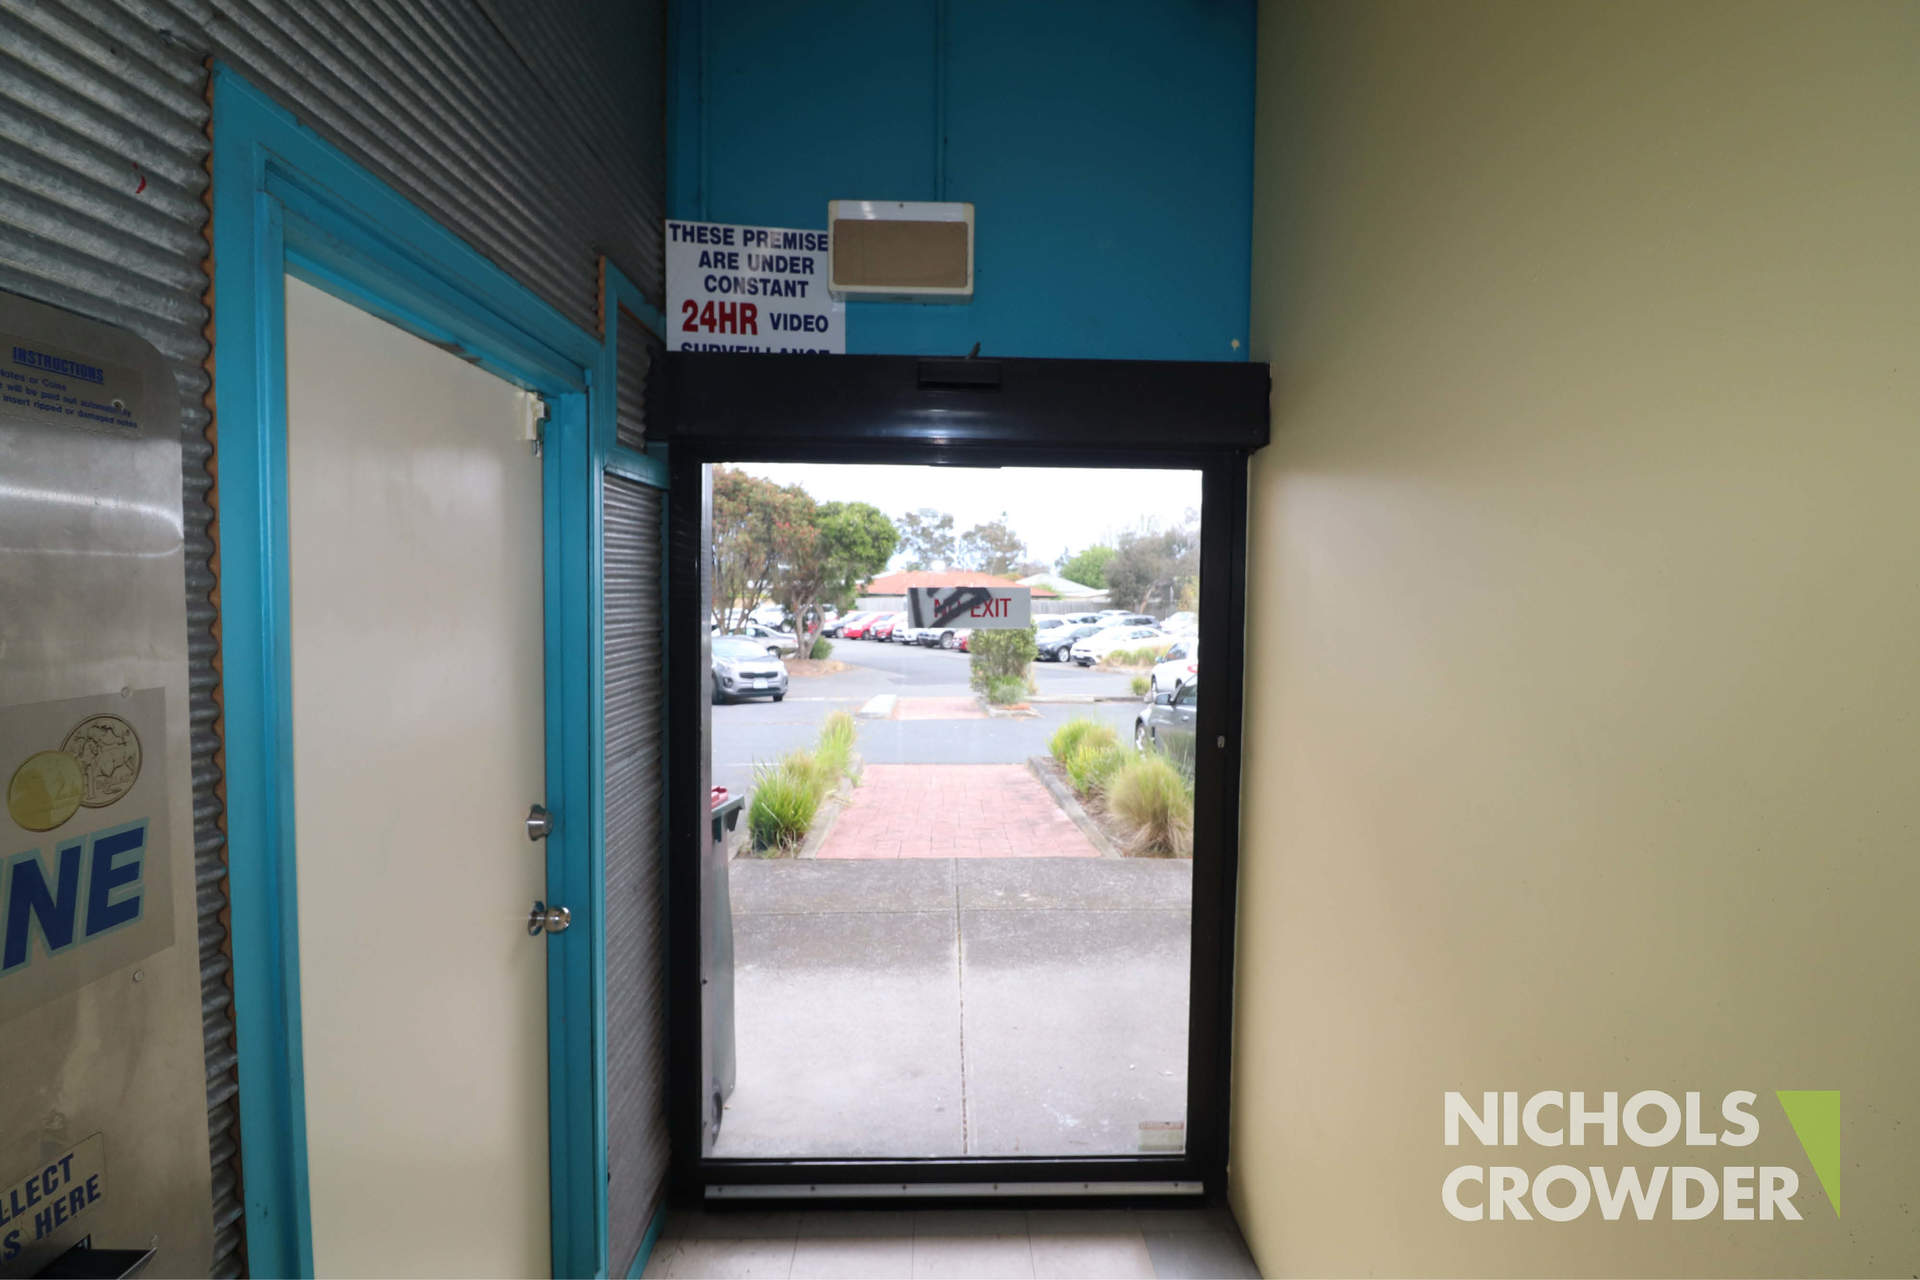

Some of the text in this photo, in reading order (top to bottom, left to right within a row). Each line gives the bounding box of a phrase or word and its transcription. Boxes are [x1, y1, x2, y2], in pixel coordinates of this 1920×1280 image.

[669, 223, 828, 252] THESE PREMISE
[698, 250, 814, 275] ARE UNDER
[704, 274, 809, 298] CONSTANT
[682, 299, 829, 335] 24HR VIDEO
[13, 346, 104, 384] INSTRUCTIONS
[34, 400, 63, 413] ripped
[78, 410, 114, 424] damaged
[34, 1173, 101, 1241] HERE
